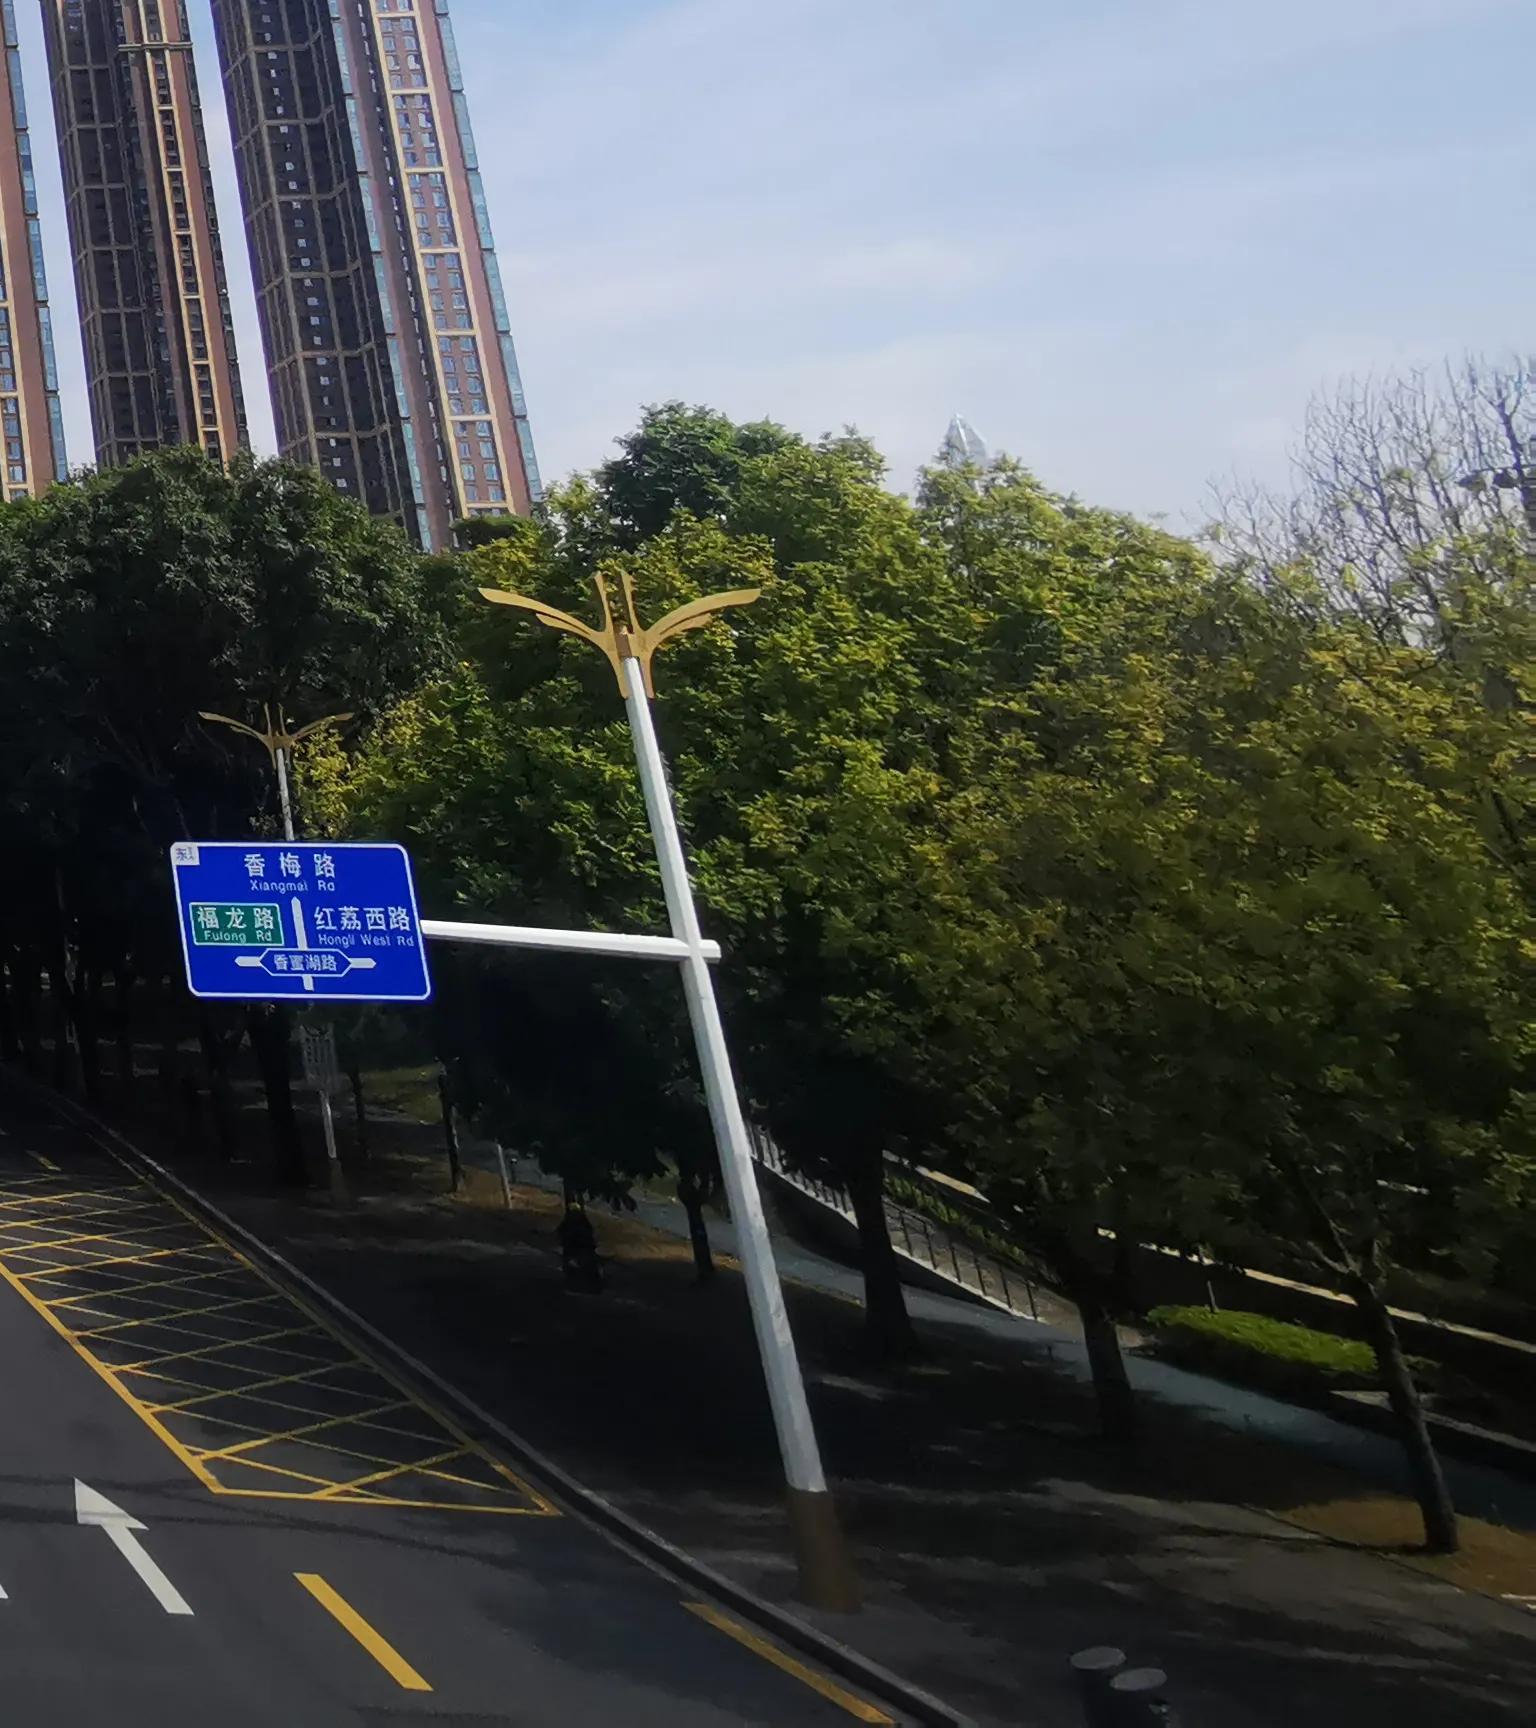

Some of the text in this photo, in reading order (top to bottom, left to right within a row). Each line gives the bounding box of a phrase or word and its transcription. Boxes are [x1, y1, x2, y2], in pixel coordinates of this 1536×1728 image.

[244, 852, 336, 878] 香梅路
[249, 879, 336, 894] Xiangmei Rd
[196, 906, 275, 930] 福龙路
[314, 906, 411, 931] 红荔西路
[204, 930, 273, 944] Fulong Rd
[360, 934, 391, 946] West
[396, 935, 415, 947] Rd
